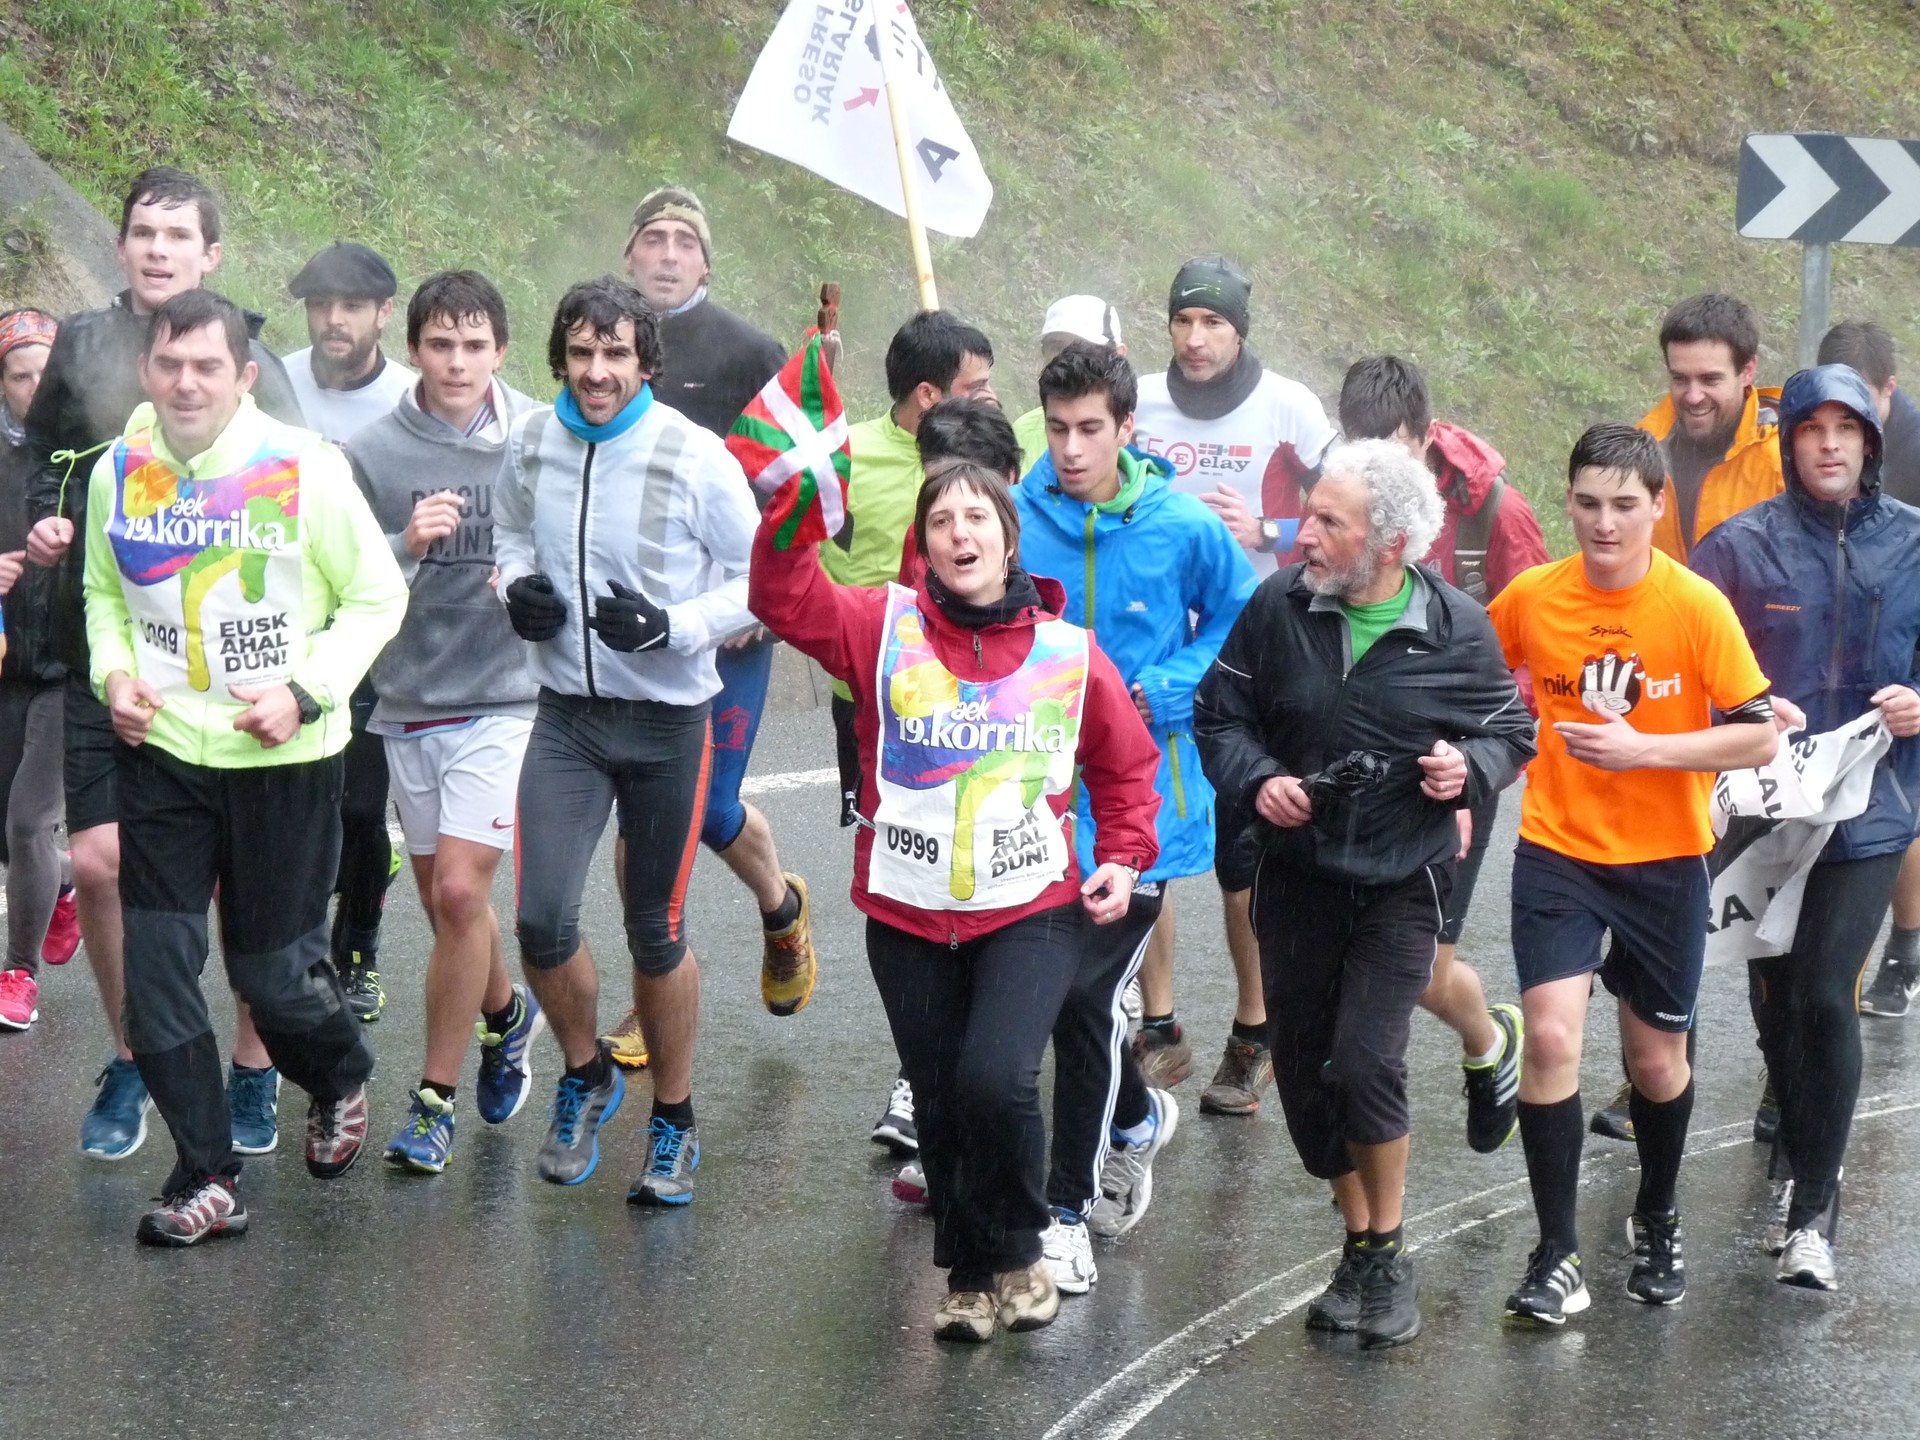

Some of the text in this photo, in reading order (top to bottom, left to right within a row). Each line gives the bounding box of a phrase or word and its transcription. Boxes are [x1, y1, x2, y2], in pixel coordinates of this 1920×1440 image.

[1199, 456, 1251, 473] elay
[171, 491, 208, 518] aek
[219, 612, 289, 638] EUSK
[219, 632, 289, 656] AHAL
[224, 650, 288, 673] DUN!
[1543, 672, 1681, 699] nik tri
[951, 694, 993, 723] aek
[887, 825, 940, 865] 0999
[991, 844, 1050, 879] DUN!
